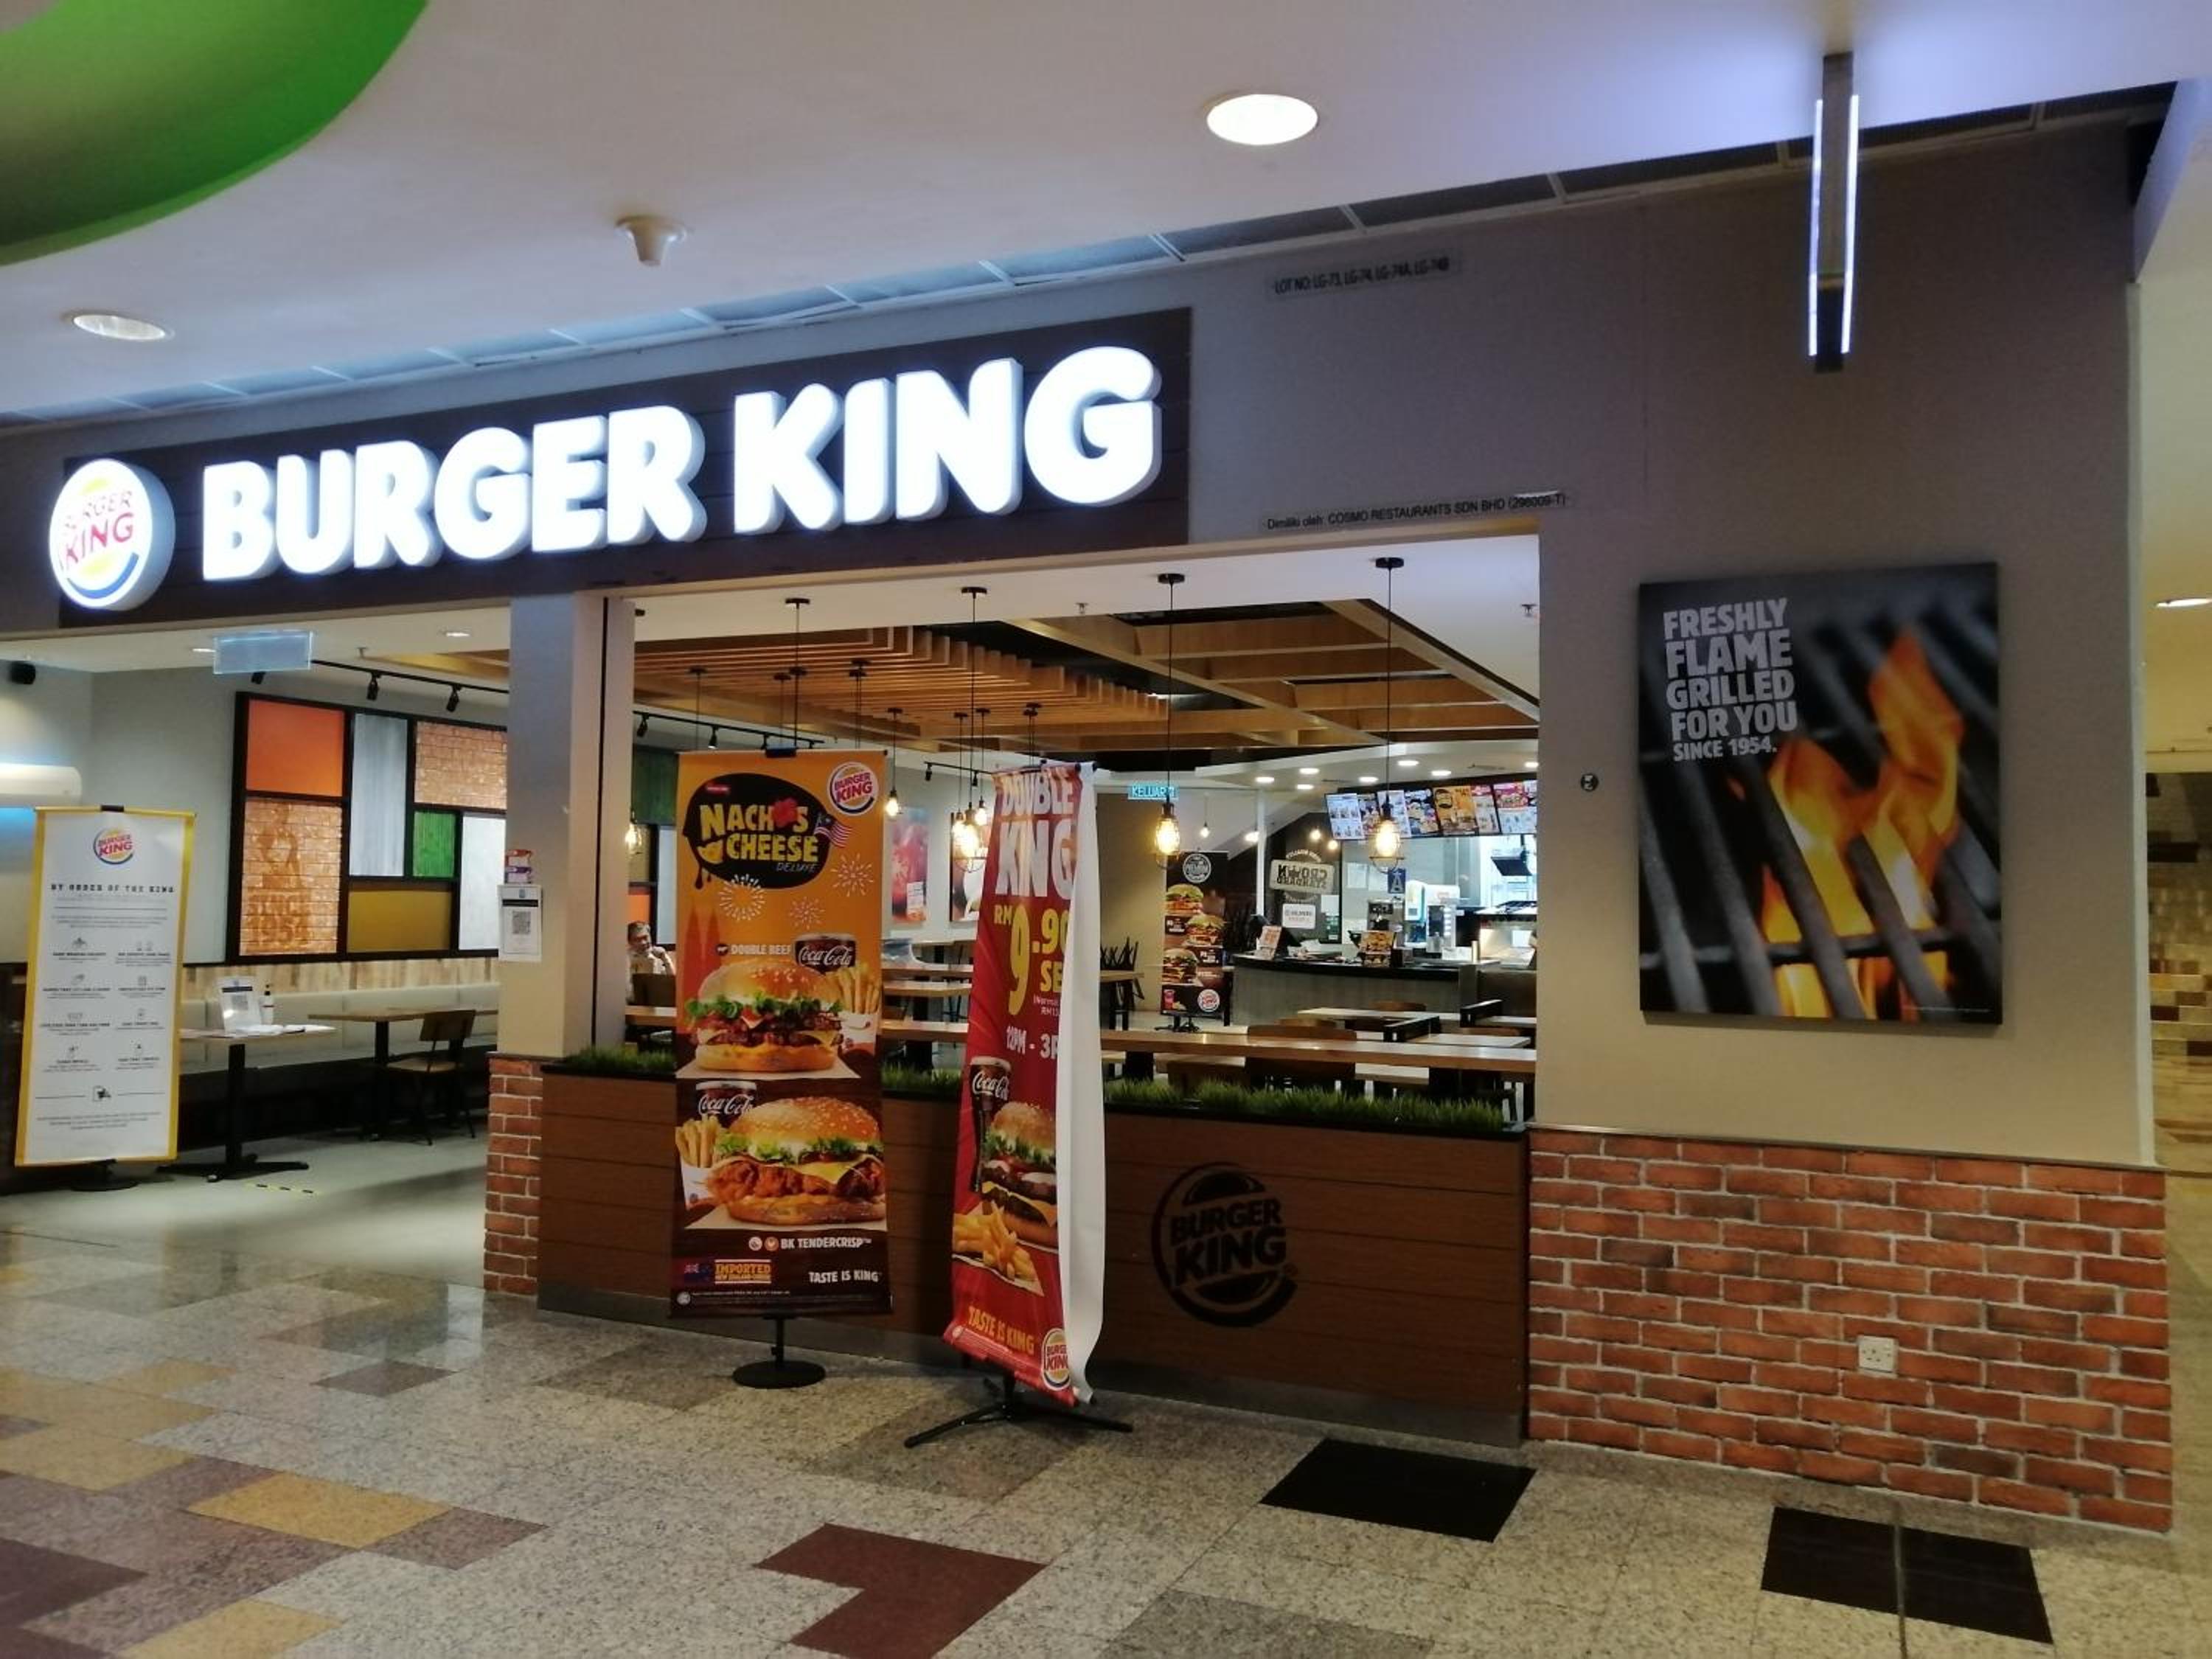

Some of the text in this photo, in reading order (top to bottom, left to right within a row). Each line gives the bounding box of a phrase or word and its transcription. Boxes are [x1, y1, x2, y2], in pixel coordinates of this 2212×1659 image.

[203, 346, 1162, 581] BURGER KING
[63, 490, 133, 537] BRGER
[1327, 510, 1368, 524] COSMO
[1371, 503, 1452, 521] RESTAURANTS
[1455, 500, 1478, 515] SDN
[1481, 498, 1505, 512] BHD
[65, 512, 134, 571] KING
[1663, 598, 1787, 640] FRESHLY
[1666, 629, 1793, 679] FLAME
[1666, 669, 1795, 710] GRILLED
[1671, 700, 1798, 742] FOR YOU
[1673, 740, 1723, 762] SINCE
[834, 772, 871, 791] BURGER
[835, 782, 873, 803] KING
[1001, 767, 1074, 815] DOUBLE
[700, 797, 809, 840] NACHS
[98, 842, 133, 856] KING
[726, 833, 818, 862] CHEESE
[995, 818, 1076, 900] KING
[994, 905, 1013, 926] RM
[731, 945, 791, 955] DOUBLE BEEF
[1040, 961, 1062, 992] SE
[1040, 1033, 1059, 1060] 3P
[1171, 1198, 1283, 1246] BURGER
[781, 1238, 796, 1249] BK
[1175, 1226, 1287, 1286] KING
[715, 1263, 771, 1274] IMPORTED
[809, 1270, 879, 1283] TASTE IS KING
[968, 1306, 996, 1336] TASTE
[998, 1320, 1006, 1341] IS
[1006, 1326, 1035, 1355] KING
[1046, 1344, 1067, 1356] BURGE
